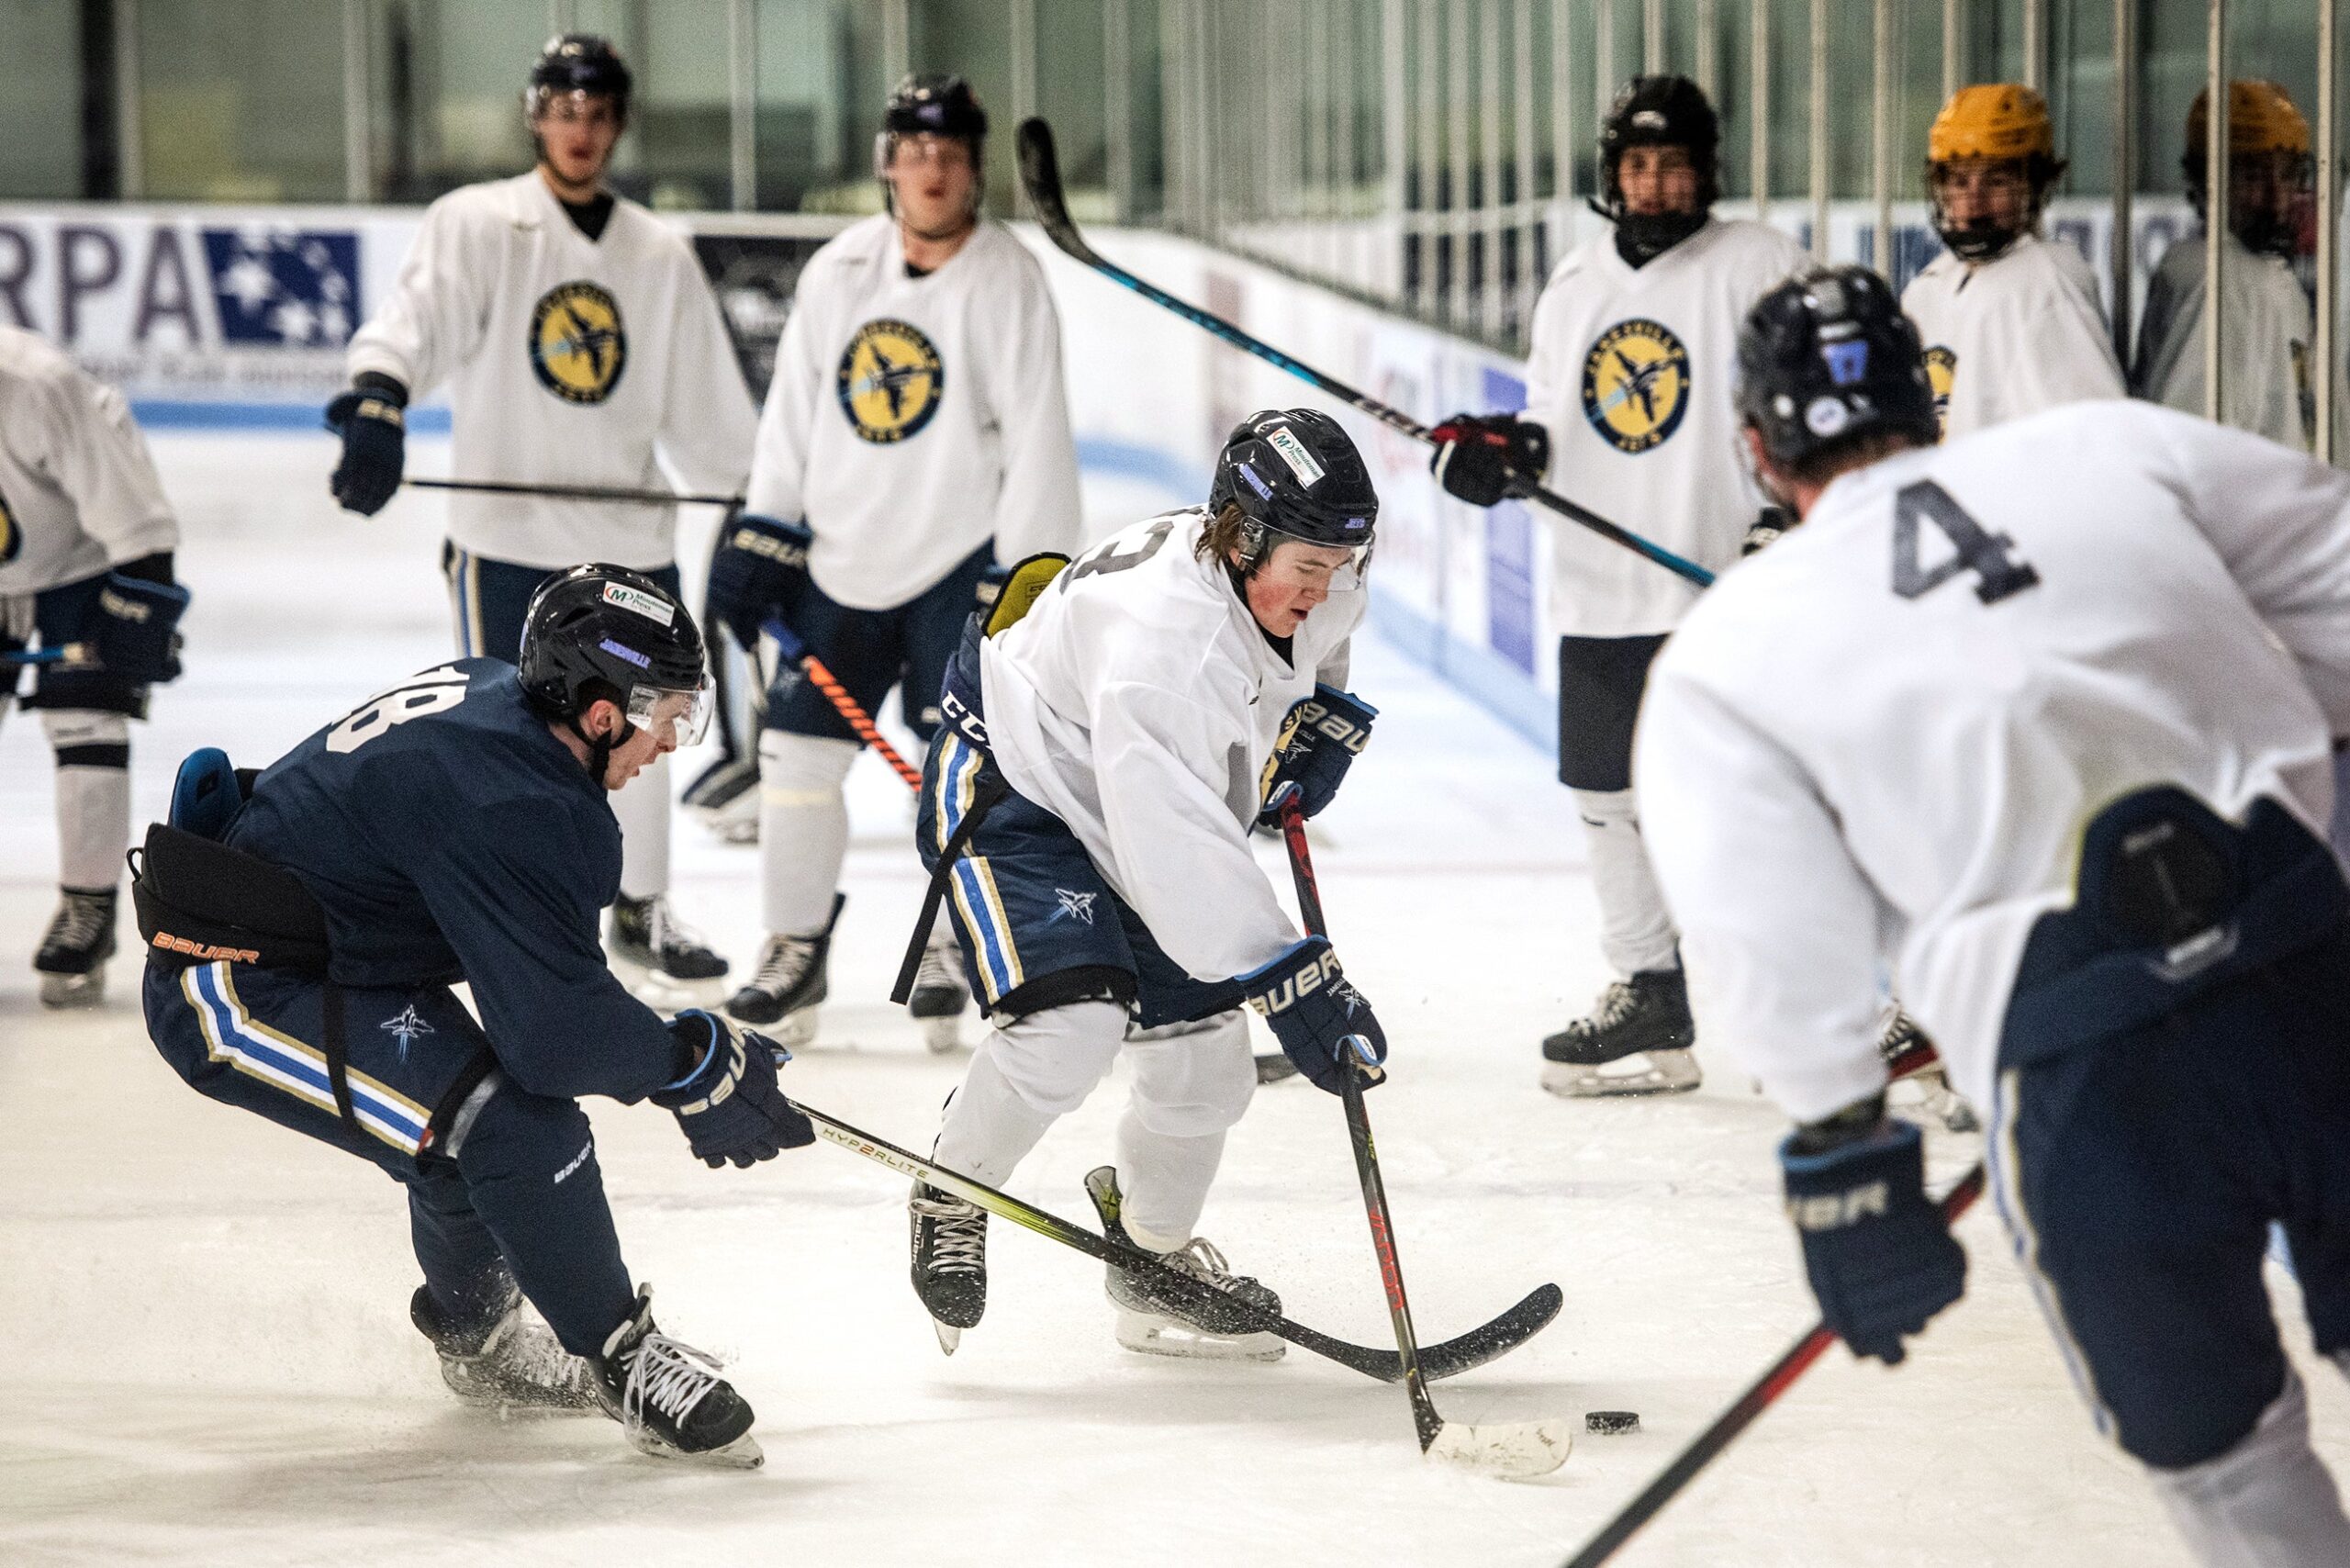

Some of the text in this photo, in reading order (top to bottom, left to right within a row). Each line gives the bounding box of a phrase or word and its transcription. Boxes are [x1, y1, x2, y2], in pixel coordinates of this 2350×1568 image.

[1288, 450, 1302, 465] Press
[1294, 447, 1321, 478] Minuteman
[1892, 478, 2040, 606] 4
[941, 690, 993, 751] CC
[1301, 700, 1371, 753] BAU
[151, 931, 260, 964] BAUER
[1248, 948, 1341, 1016] AUER
[554, 1139, 592, 1183] BAUER
